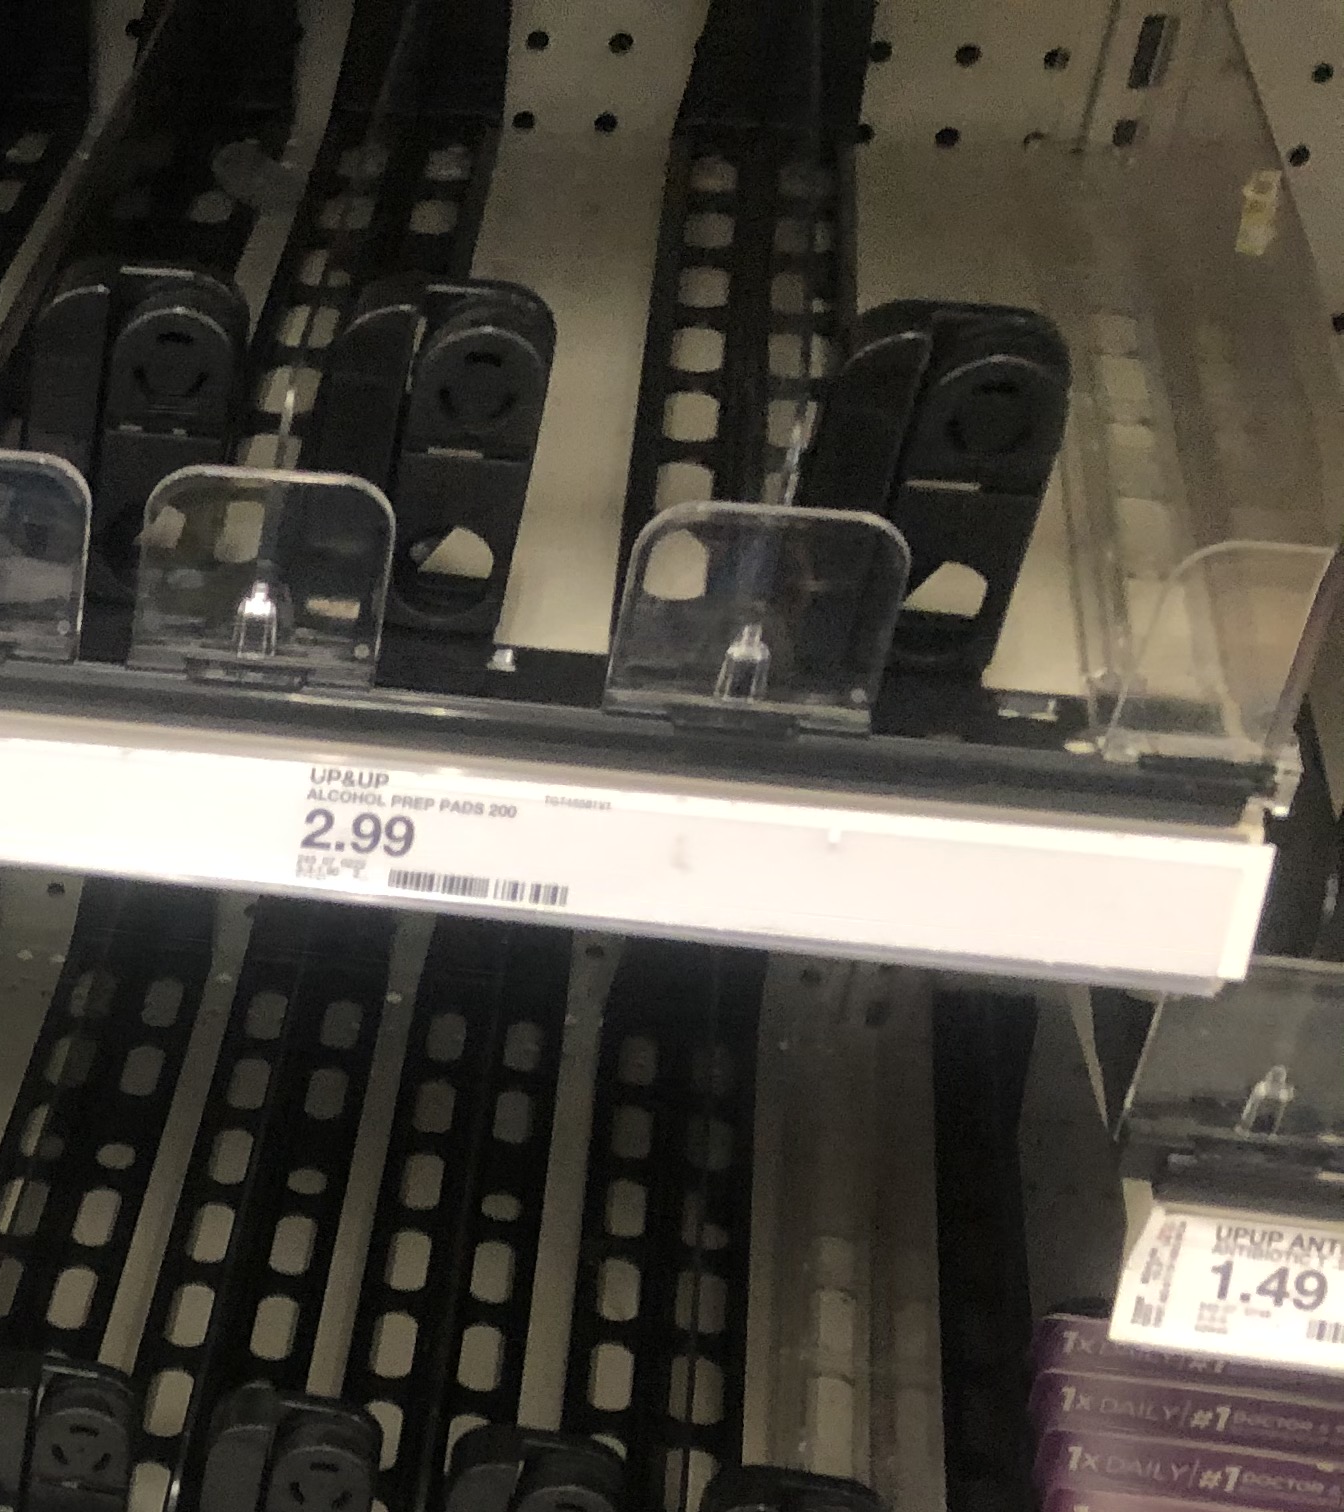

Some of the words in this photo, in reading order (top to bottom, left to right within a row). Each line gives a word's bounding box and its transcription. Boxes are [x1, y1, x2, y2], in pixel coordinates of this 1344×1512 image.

[309, 767, 391, 790] UP&UP
[306, 787, 387, 808] ALCOHOL
[390, 794, 436, 812] PREP
[438, 799, 485, 816] PADS
[487, 803, 518, 820] 200
[299, 807, 416, 858] 2.99
[1210, 1259, 1329, 1312] 1.49
